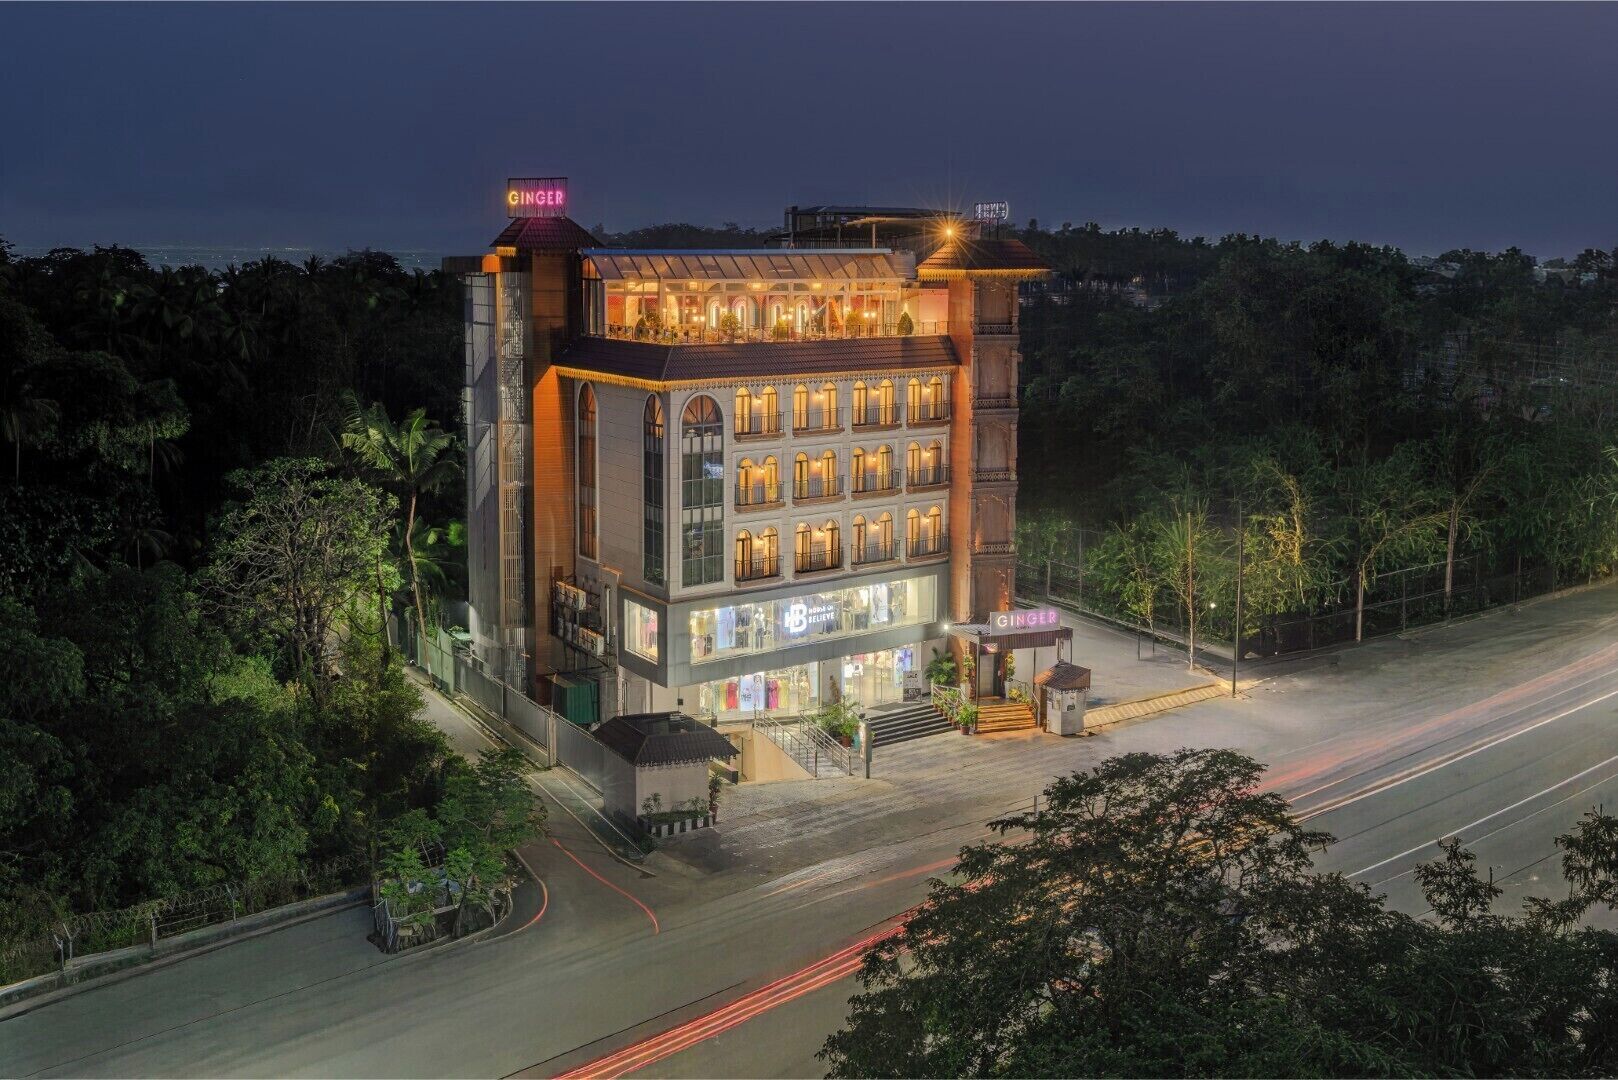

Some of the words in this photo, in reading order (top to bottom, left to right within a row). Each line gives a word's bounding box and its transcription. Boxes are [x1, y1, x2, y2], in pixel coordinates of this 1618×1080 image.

[508, 190, 563, 205] GINGER
[808, 612, 835, 624] BELIEVE
[997, 611, 1056, 627] GINGER
